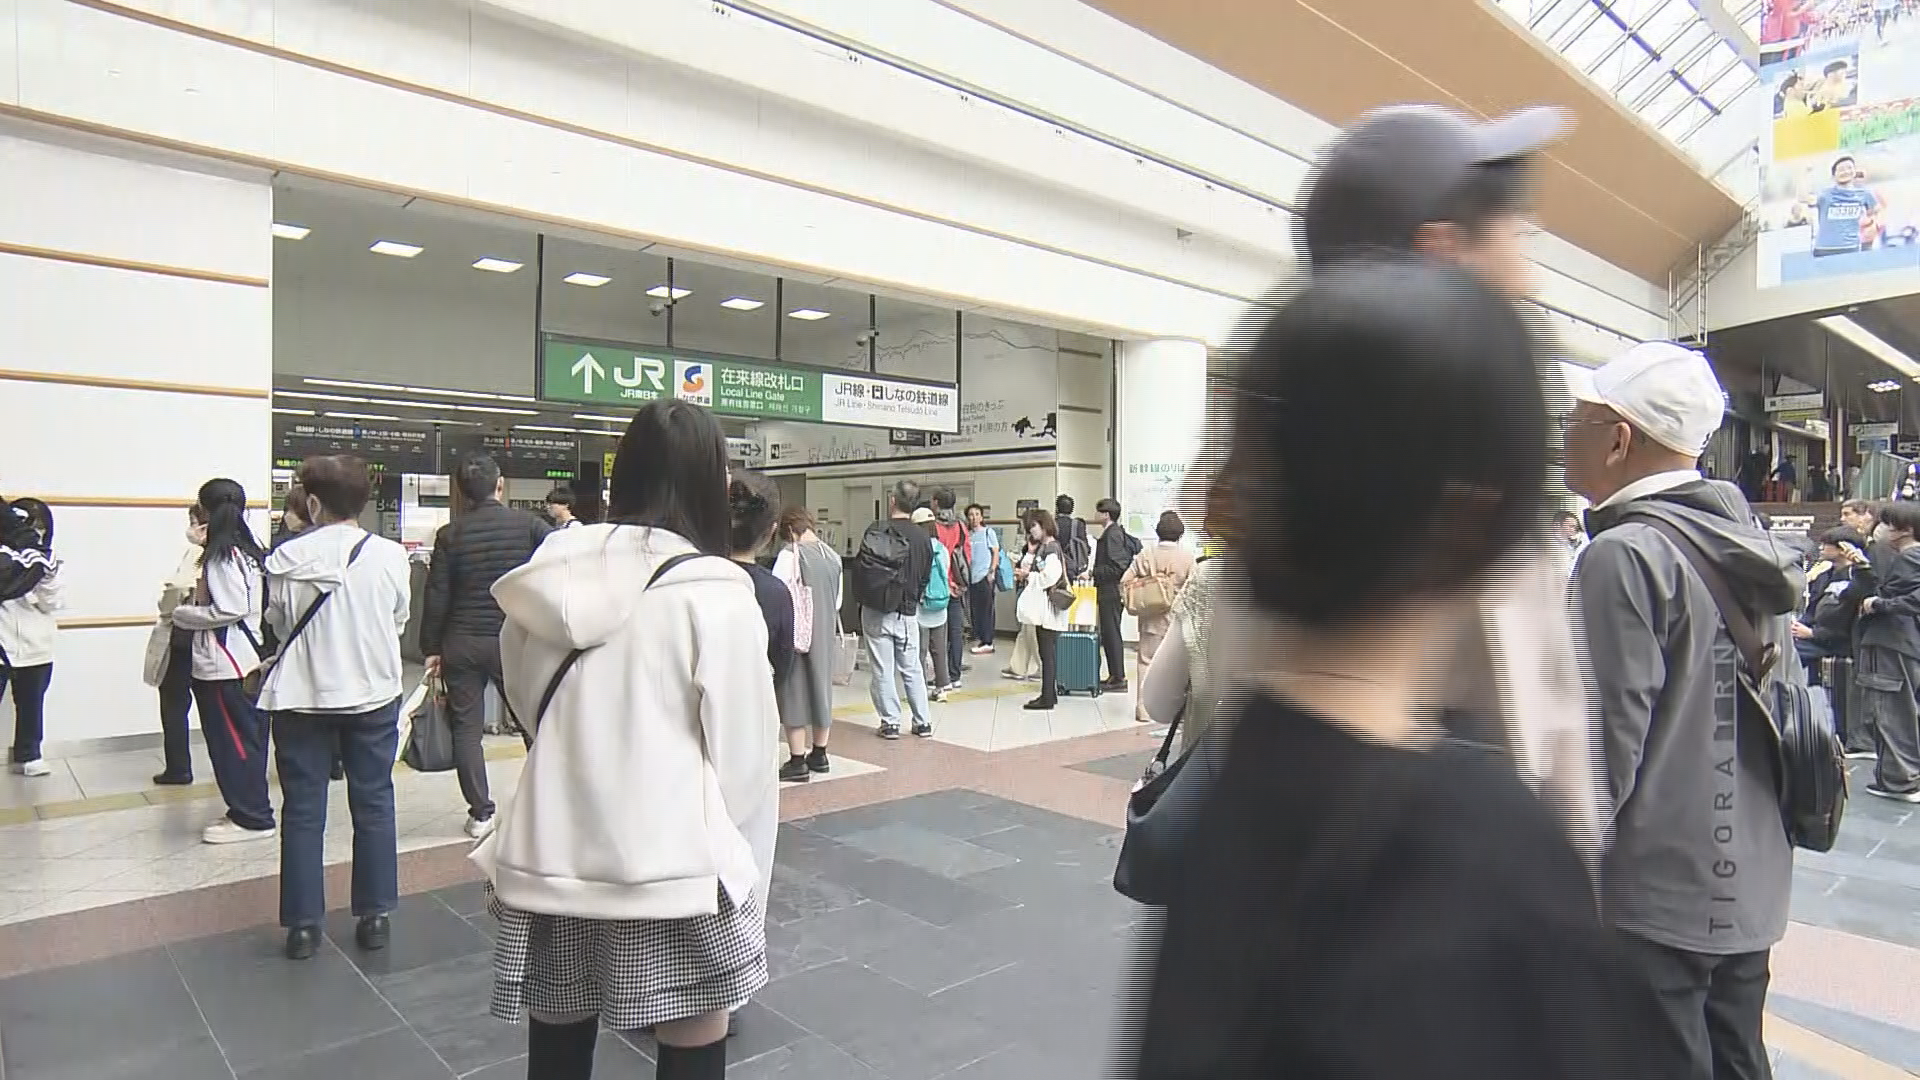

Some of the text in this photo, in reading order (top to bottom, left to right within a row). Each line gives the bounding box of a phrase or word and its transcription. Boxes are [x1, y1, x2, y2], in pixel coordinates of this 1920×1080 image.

[614, 356, 665, 391] JR
[720, 367, 804, 392] 在来線改札口
[720, 385, 785, 401] Local Line Gate
[1708, 756, 1737, 935] TIGORA
